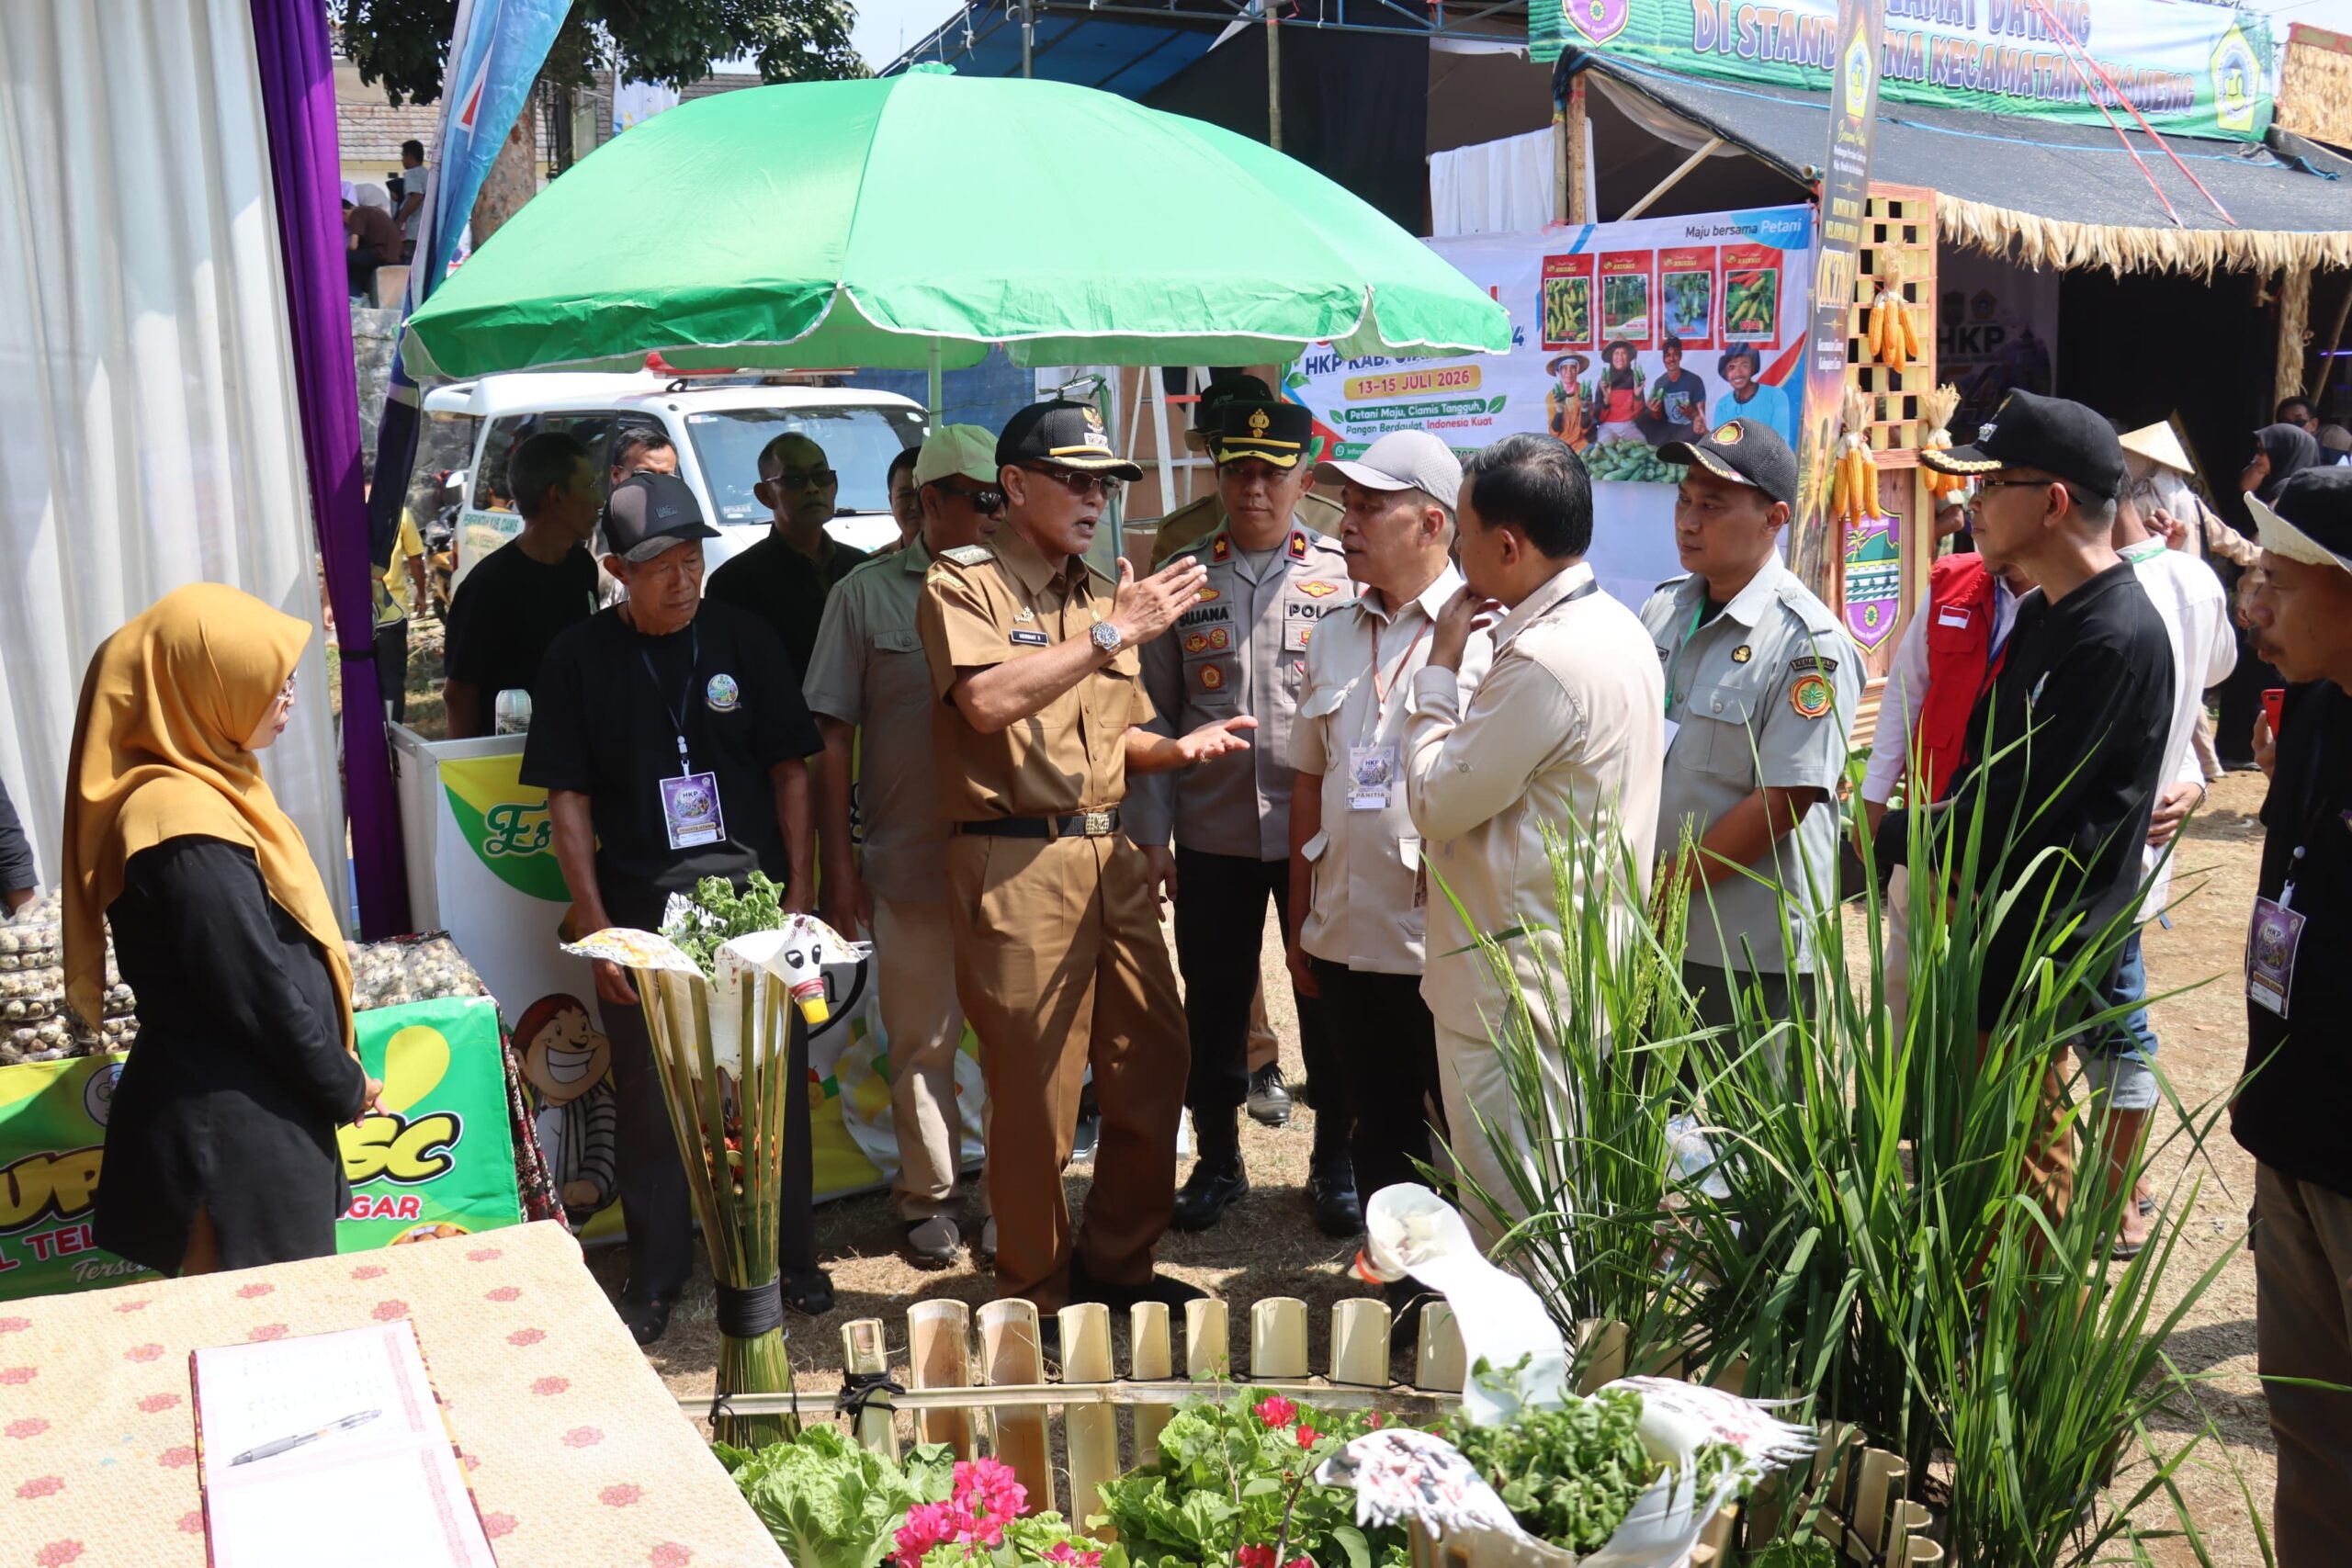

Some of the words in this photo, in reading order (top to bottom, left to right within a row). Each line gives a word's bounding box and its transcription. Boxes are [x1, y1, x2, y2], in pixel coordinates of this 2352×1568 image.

[1692, 0, 1732, 52] DI
[1737, 6, 1838, 69] STAND
[1930, 34, 2085, 105] KECAMATAN
[2087, 59, 2195, 116] CIKONENG
[1685, 226, 1710, 240] Maju
[1713, 223, 1758, 237] bersama
[1760, 218, 1802, 234] Petani
[1937, 326, 2006, 355] HKP
[1305, 352, 1342, 376] HKP
[1358, 378, 1396, 395] 13-15
[1401, 374, 1432, 391] JULI
[1437, 369, 1470, 387] 2026
[1350, 409, 1379, 420] Petani
[1381, 406, 1406, 422] Maju,
[1408, 404, 1439, 416] Ciamis
[1440, 402, 1482, 417] Tangguh,
[1346, 424, 1377, 436] Pangan
[1426, 418, 1469, 430] Indonesia
[1471, 416, 1493, 427] Kuat
[1179, 605, 1229, 627] SUJANA
[2266, 925, 2282, 939] HKP
[339, 1194, 423, 1222] GAR
[23, 1223, 97, 1260] TEL
